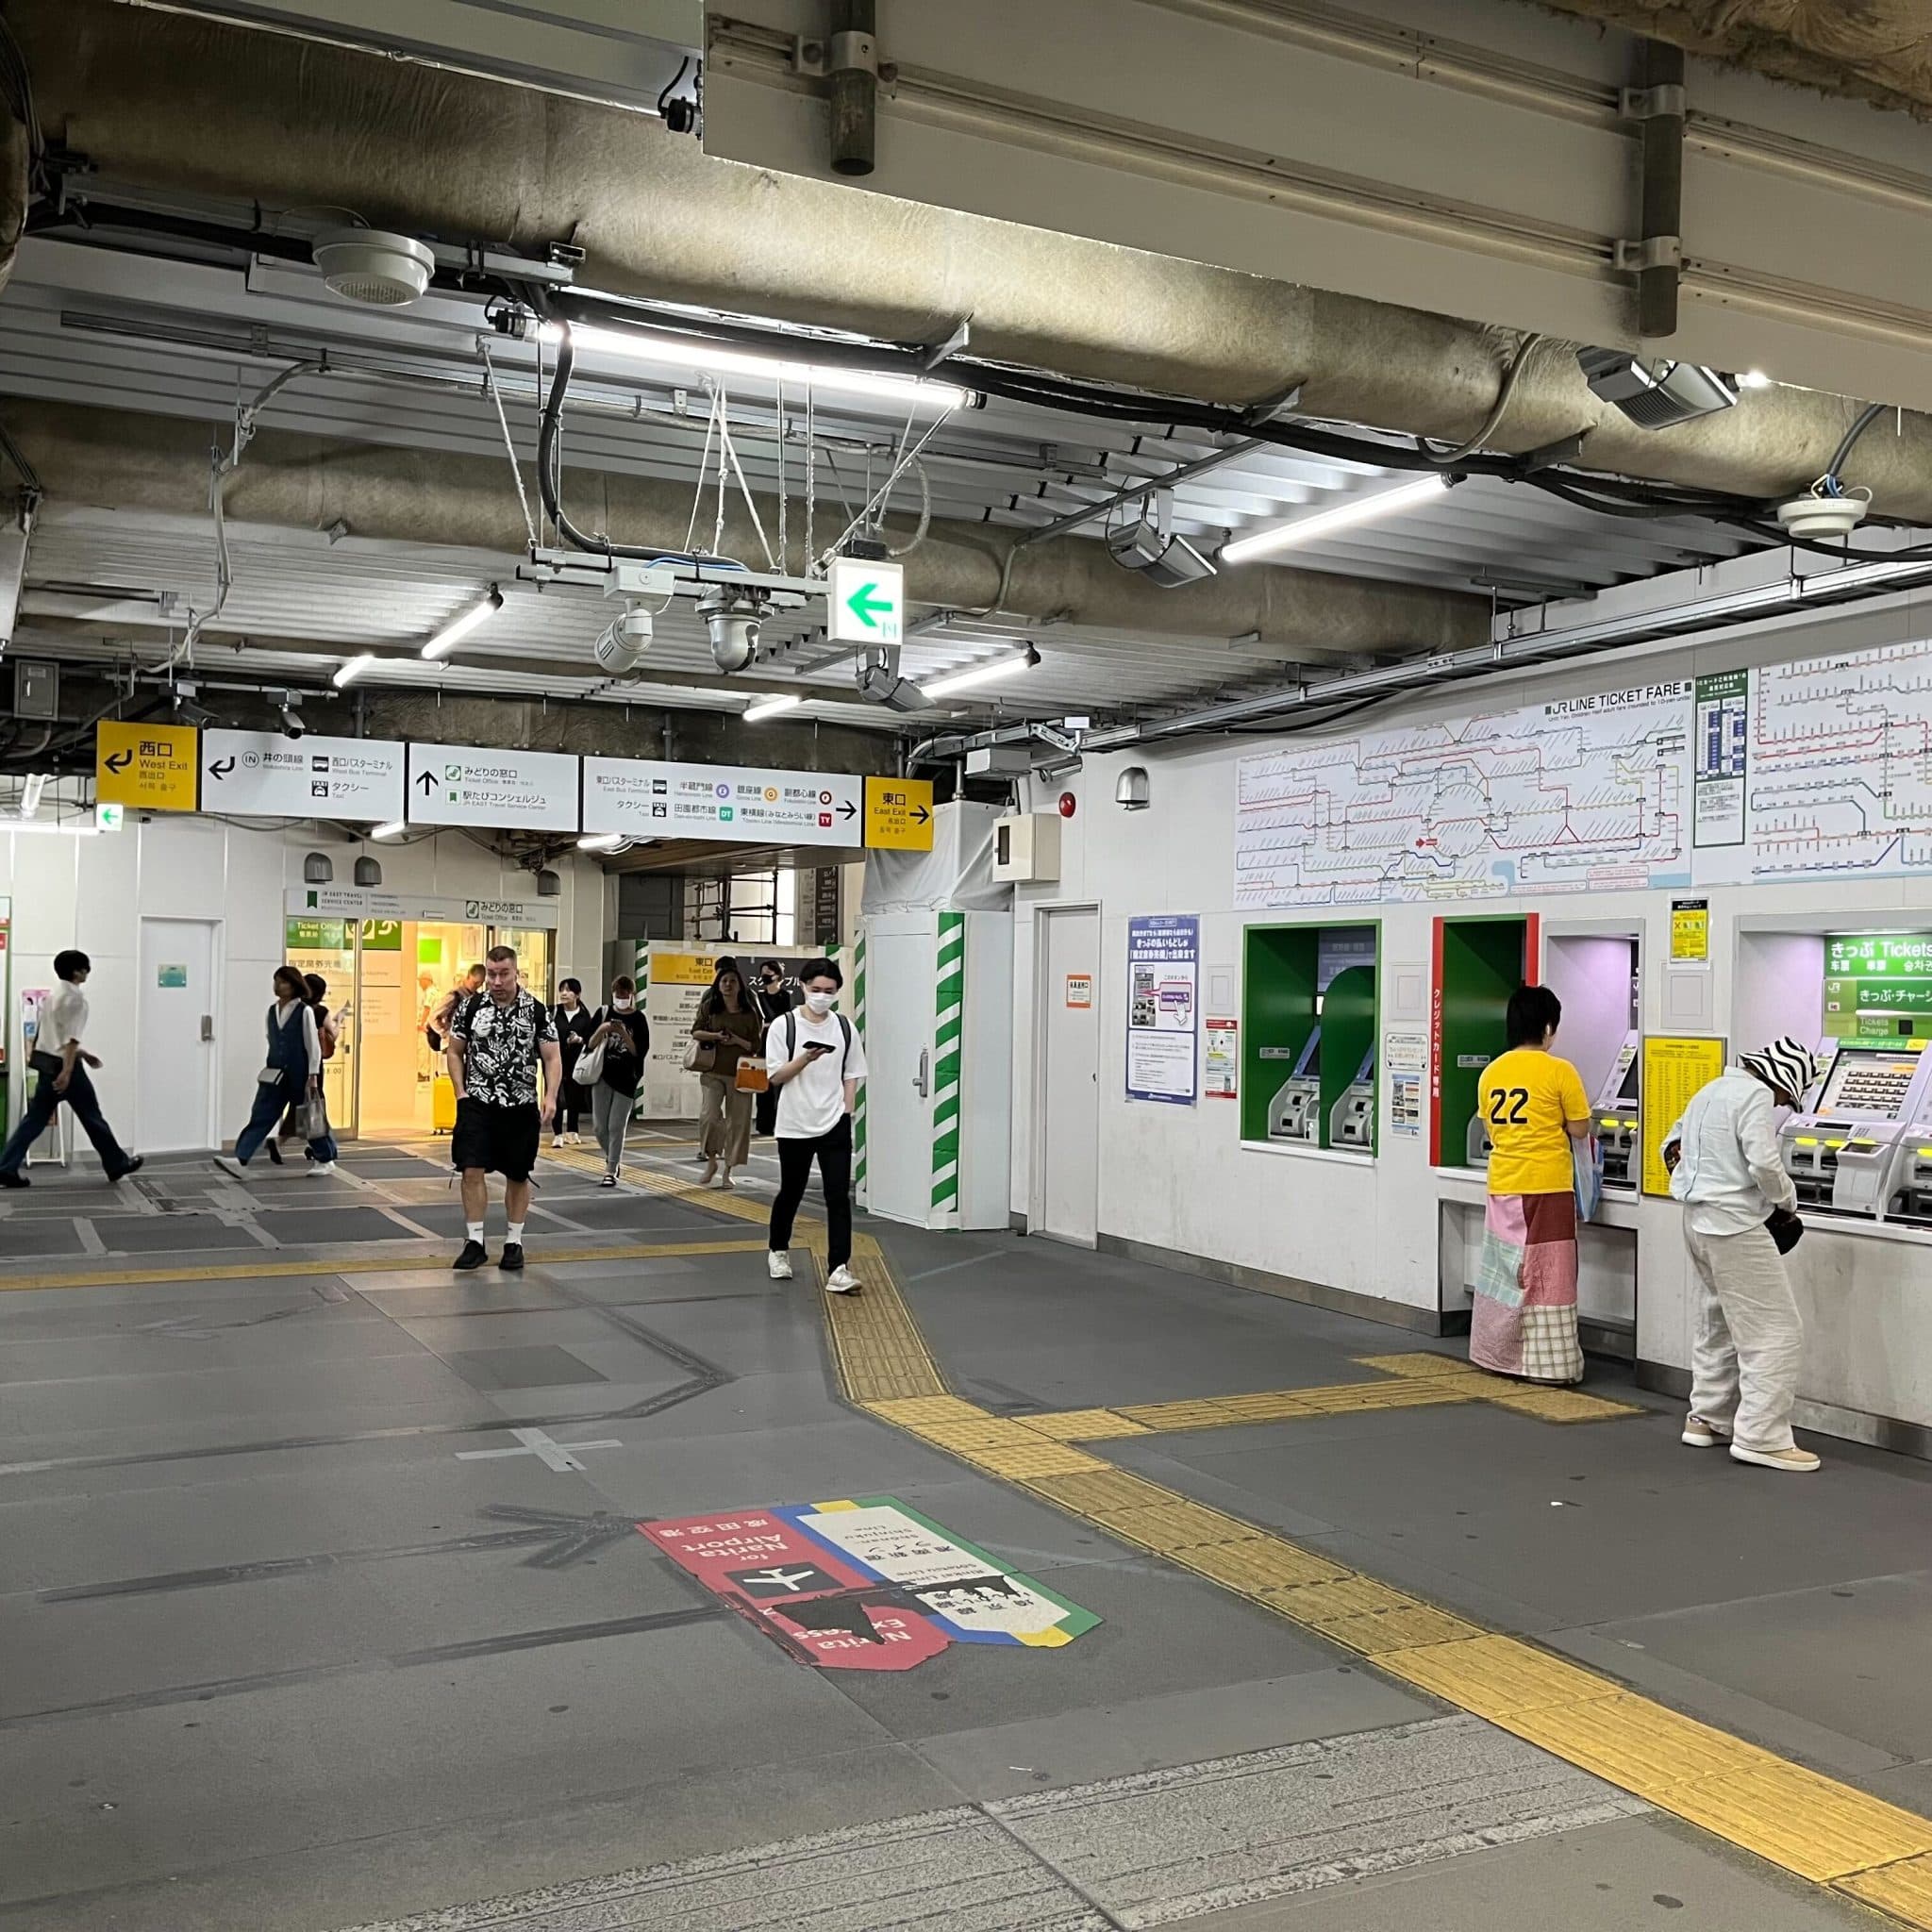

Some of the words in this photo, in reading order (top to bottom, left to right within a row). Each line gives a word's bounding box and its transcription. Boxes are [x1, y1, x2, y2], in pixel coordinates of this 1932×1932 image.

[1569, 696, 1595, 712] LINE
[1599, 689, 1642, 707] TICKET
[1646, 682, 1681, 700] FARE
[139, 741, 172, 758] 西口
[139, 758, 165, 769] West
[168, 761, 188, 771] Exit
[262, 752, 304, 764] 井の頭線
[332, 757, 392, 770] 西口バスターミナル
[465, 766, 518, 778] みどりの窓口
[332, 782, 369, 792] タクシー
[596, 776, 650, 787] 東口バスターミナル
[737, 785, 761, 794] 銀座線
[463, 791, 546, 804] 駅たびコンシェルジュ
[883, 792, 906, 806] 東口
[617, 801, 649, 809] タクシー
[675, 804, 716, 813] 田園都市線
[480, 902, 523, 914] みどりの窓口
[1831, 941, 1874, 958] きっぷ
[1882, 941, 1932, 958] Tickets
[695, 958, 712, 966] 東口
[1828, 982, 1840, 993] JR
[1860, 1026, 1889, 1036] Charge
[1490, 1088, 1529, 1124] 22
[659, 1518, 769, 1537] 成田空港
[681, 1534, 781, 1552] Airport
[699, 1541, 789, 1557] Narita
[869, 1541, 931, 1553] ライン
[864, 1545, 955, 1561] 湘南新宿
[818, 1630, 912, 1649] Nrita
